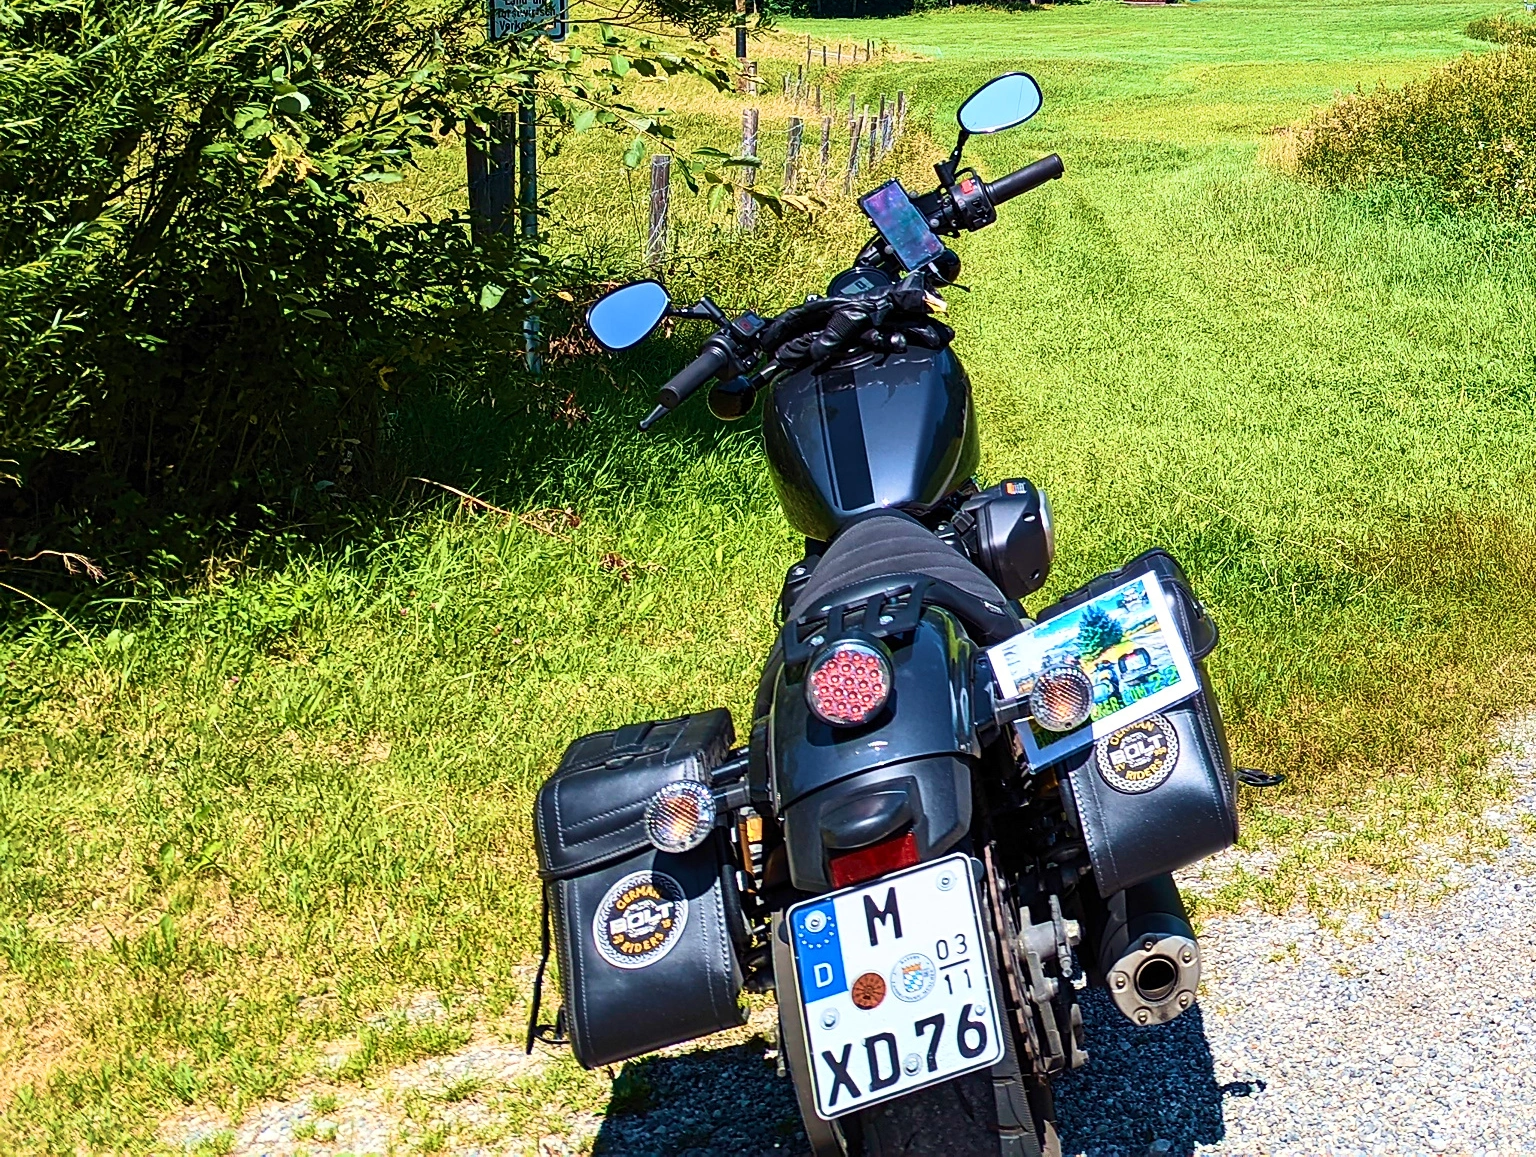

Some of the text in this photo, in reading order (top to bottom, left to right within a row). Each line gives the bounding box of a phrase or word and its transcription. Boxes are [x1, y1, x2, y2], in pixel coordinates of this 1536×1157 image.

[1109, 734, 1163, 766] BOLT
[1125, 758, 1163, 781] RIDERS
[609, 901, 674, 936] BOLT
[863, 886, 903, 947] M
[620, 931, 665, 954] RIDERS
[936, 933, 968, 961] 03
[813, 963, 834, 988] D
[944, 969, 973, 995] 11
